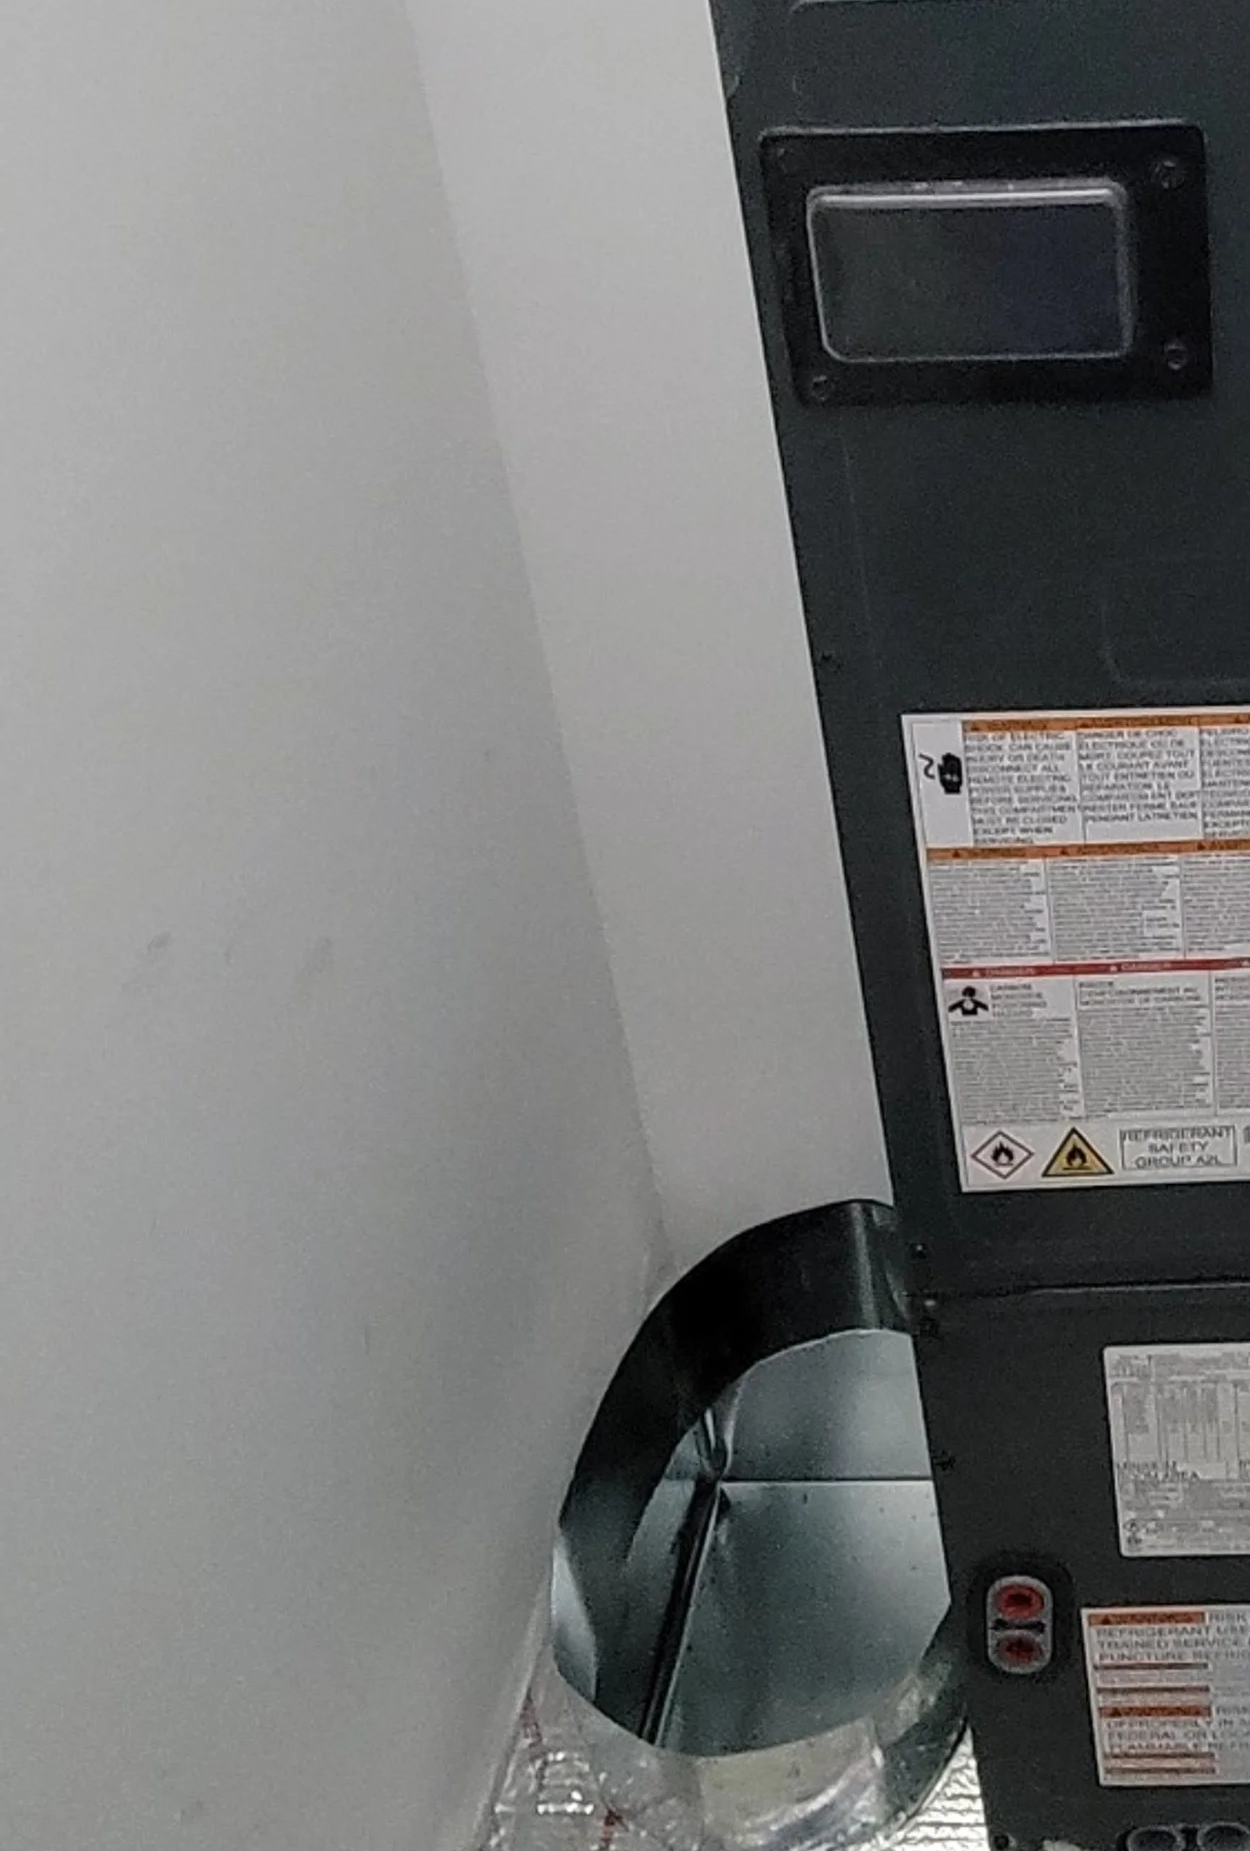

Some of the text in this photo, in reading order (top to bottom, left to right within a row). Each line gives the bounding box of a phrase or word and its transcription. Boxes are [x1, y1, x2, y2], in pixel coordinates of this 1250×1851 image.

[1123, 1126, 1231, 1141] REFRIGERANT
[1148, 1141, 1209, 1153] SAFETY
[1135, 1155, 1191, 1169] GROUP
